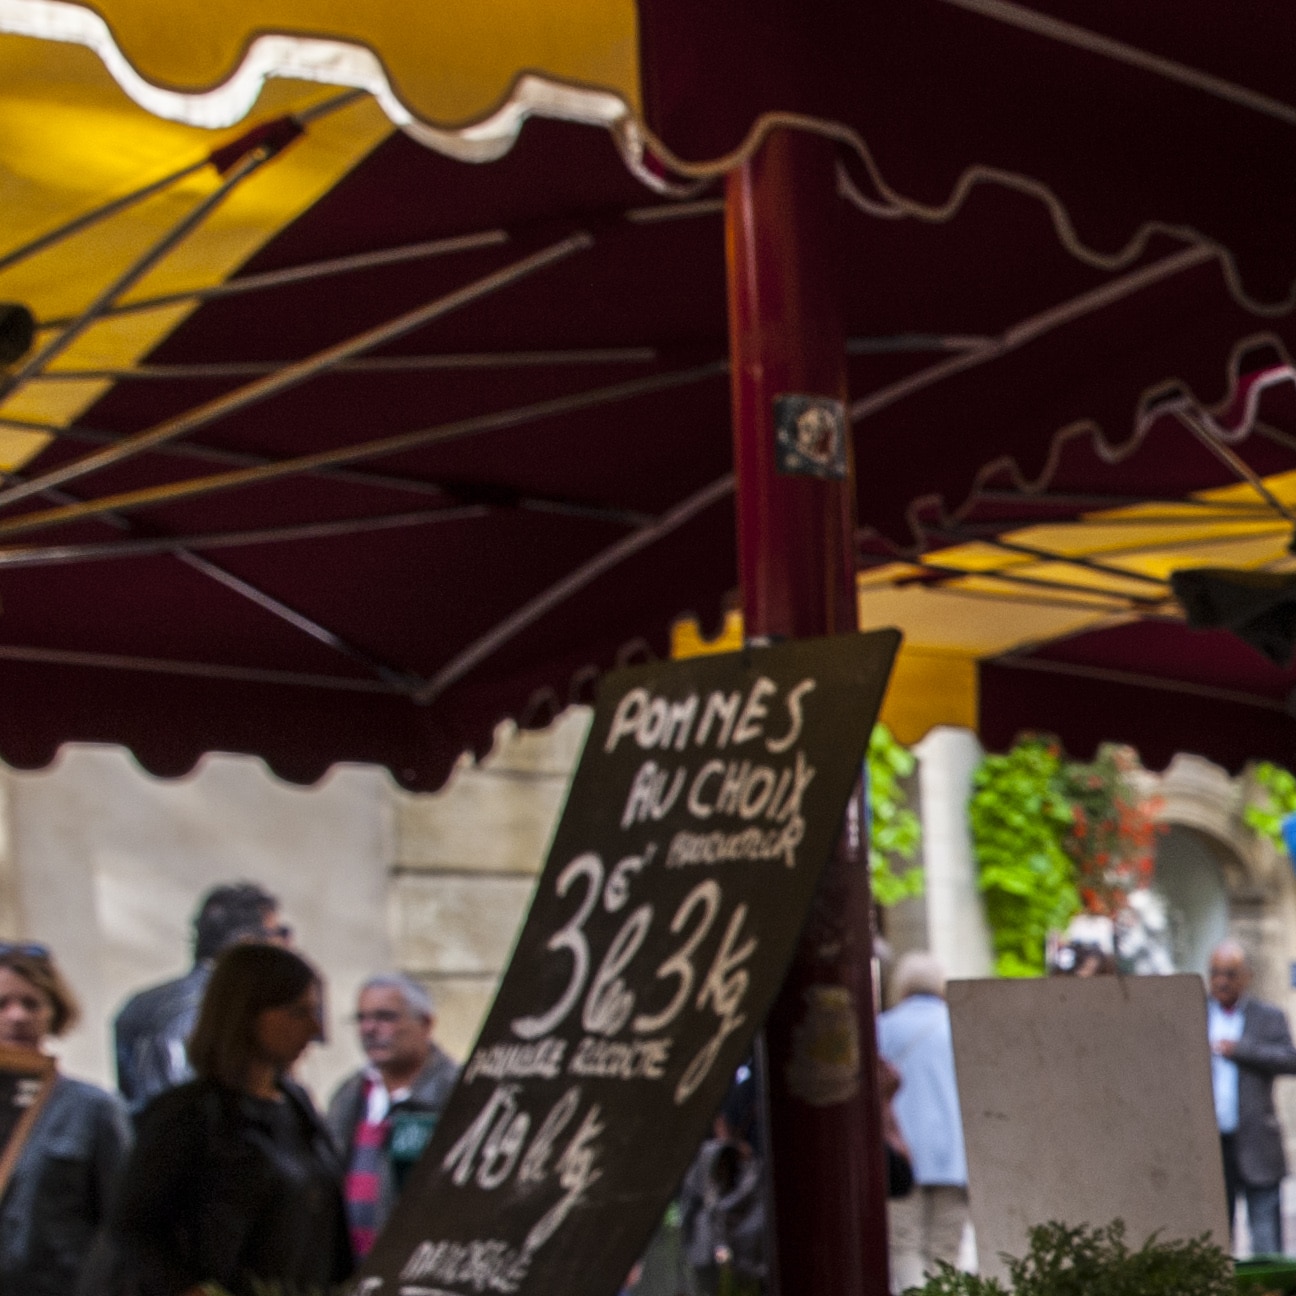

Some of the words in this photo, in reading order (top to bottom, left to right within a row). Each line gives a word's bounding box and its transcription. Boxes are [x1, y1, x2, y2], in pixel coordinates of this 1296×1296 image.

[604, 676, 816, 753] POMMES
[620, 760, 686, 830] AU
[687, 751, 816, 823] CHOIX
